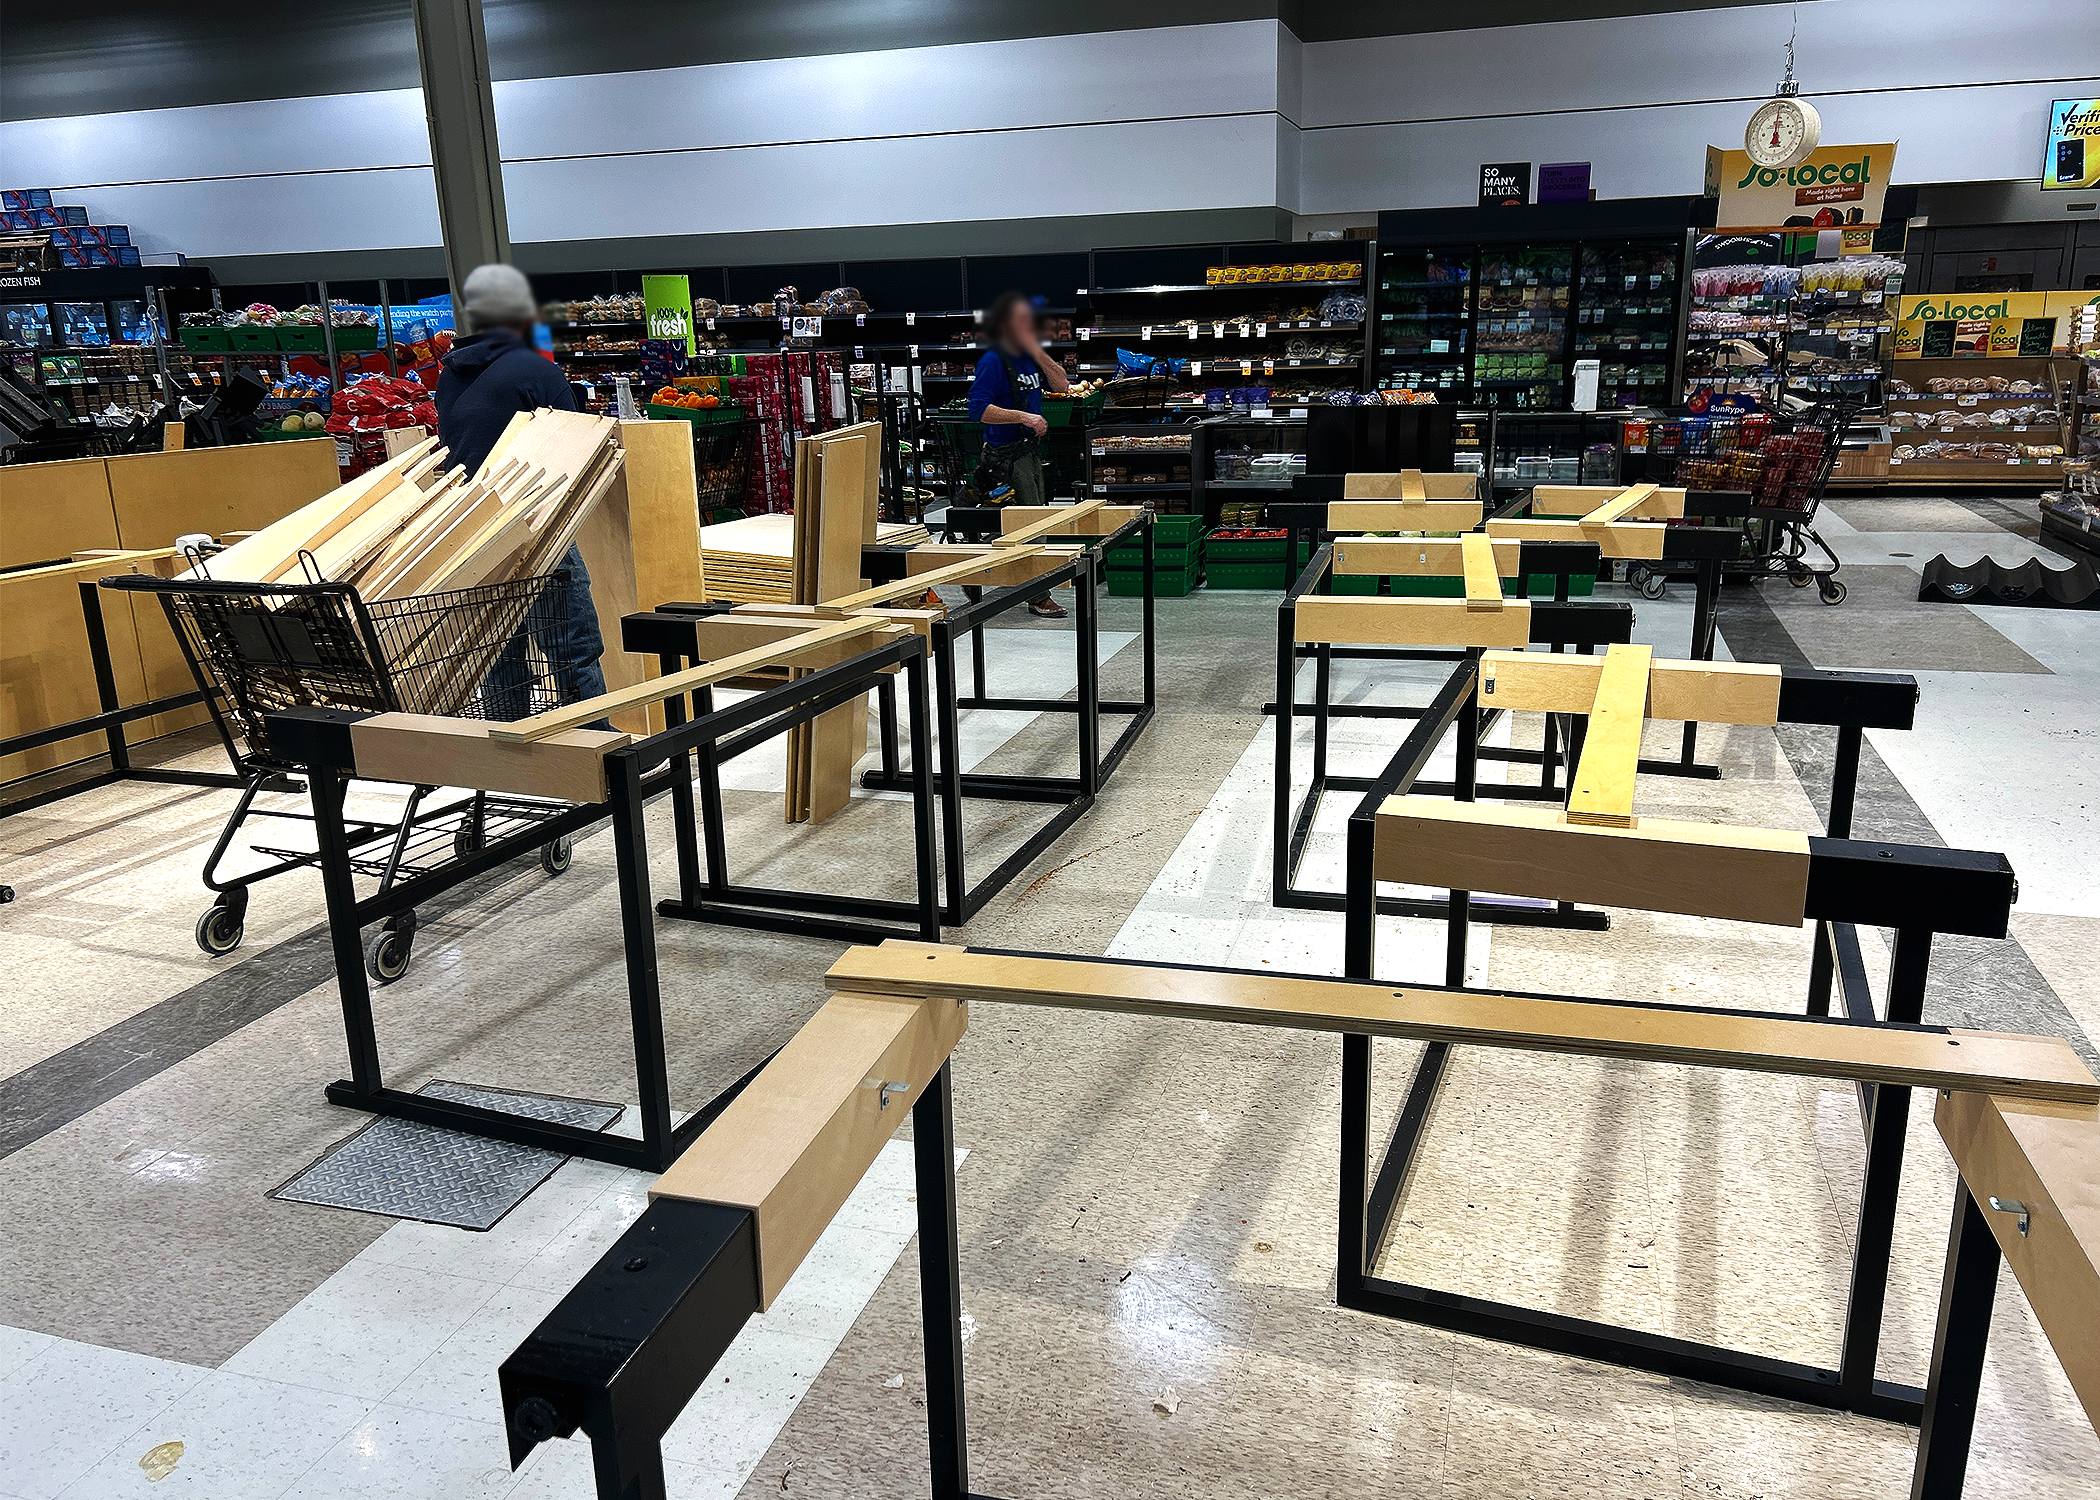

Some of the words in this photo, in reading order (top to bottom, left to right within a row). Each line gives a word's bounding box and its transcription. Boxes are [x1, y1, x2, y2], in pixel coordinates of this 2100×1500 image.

[1484, 168, 1499, 177] SO
[1484, 177, 1516, 186] MANY
[1483, 186, 1521, 196] PLACES.
[1805, 188, 1824, 196] Made
[1825, 187, 1840, 195] right
[1844, 230, 1872, 240] local
[24, 276, 41, 287] FISH
[410, 308, 421, 317] the
[421, 308, 440, 317] watch
[656, 307, 676, 318] 100%
[650, 313, 688, 336] fresh
[1992, 325, 2007, 335] So
[1992, 335, 2019, 344] local
[272, 402, 292, 410] BAGS
[1710, 404, 1746, 415] SunRype
